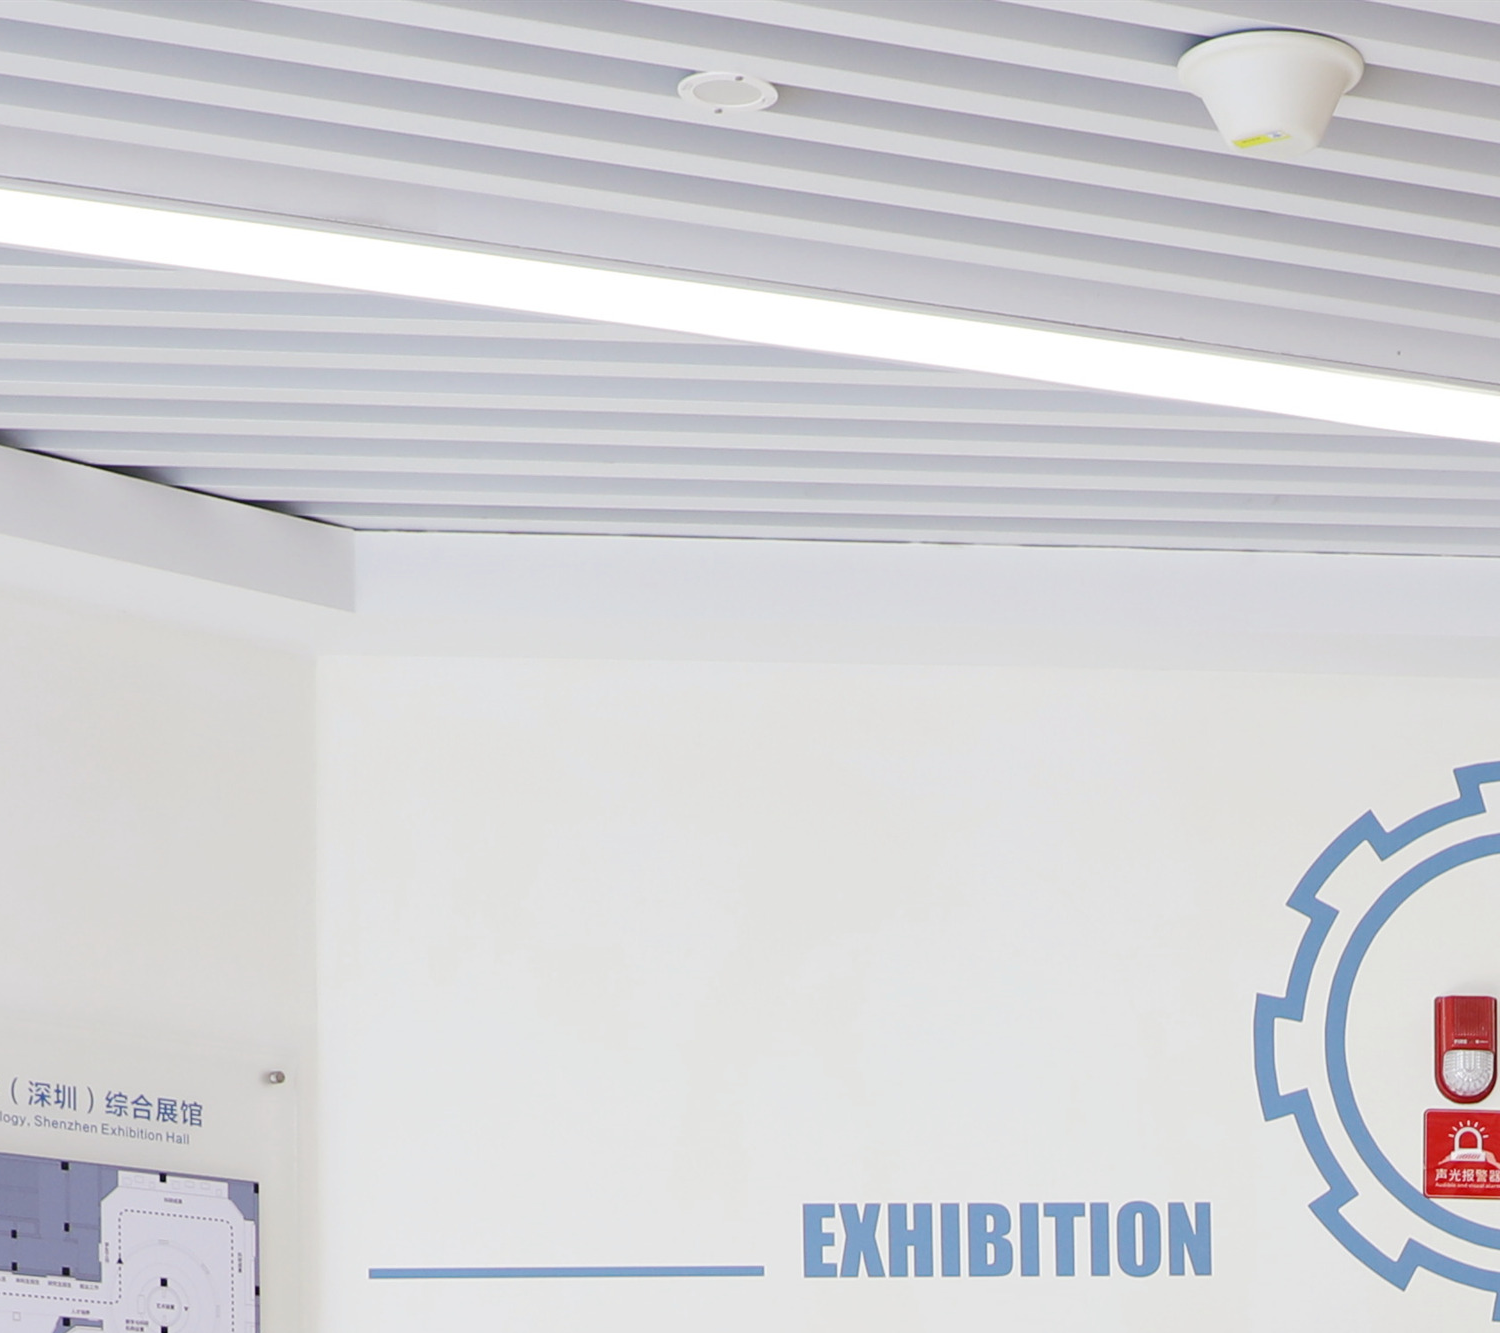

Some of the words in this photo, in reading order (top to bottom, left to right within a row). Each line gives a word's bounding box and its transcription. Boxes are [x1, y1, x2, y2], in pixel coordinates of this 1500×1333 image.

[34, 1114, 97, 1135] Shenzhen
[101, 1122, 162, 1142] Exhibition
[165, 1129, 190, 1145] Hall
[802, 1200, 1213, 1278] EXHIBITION
